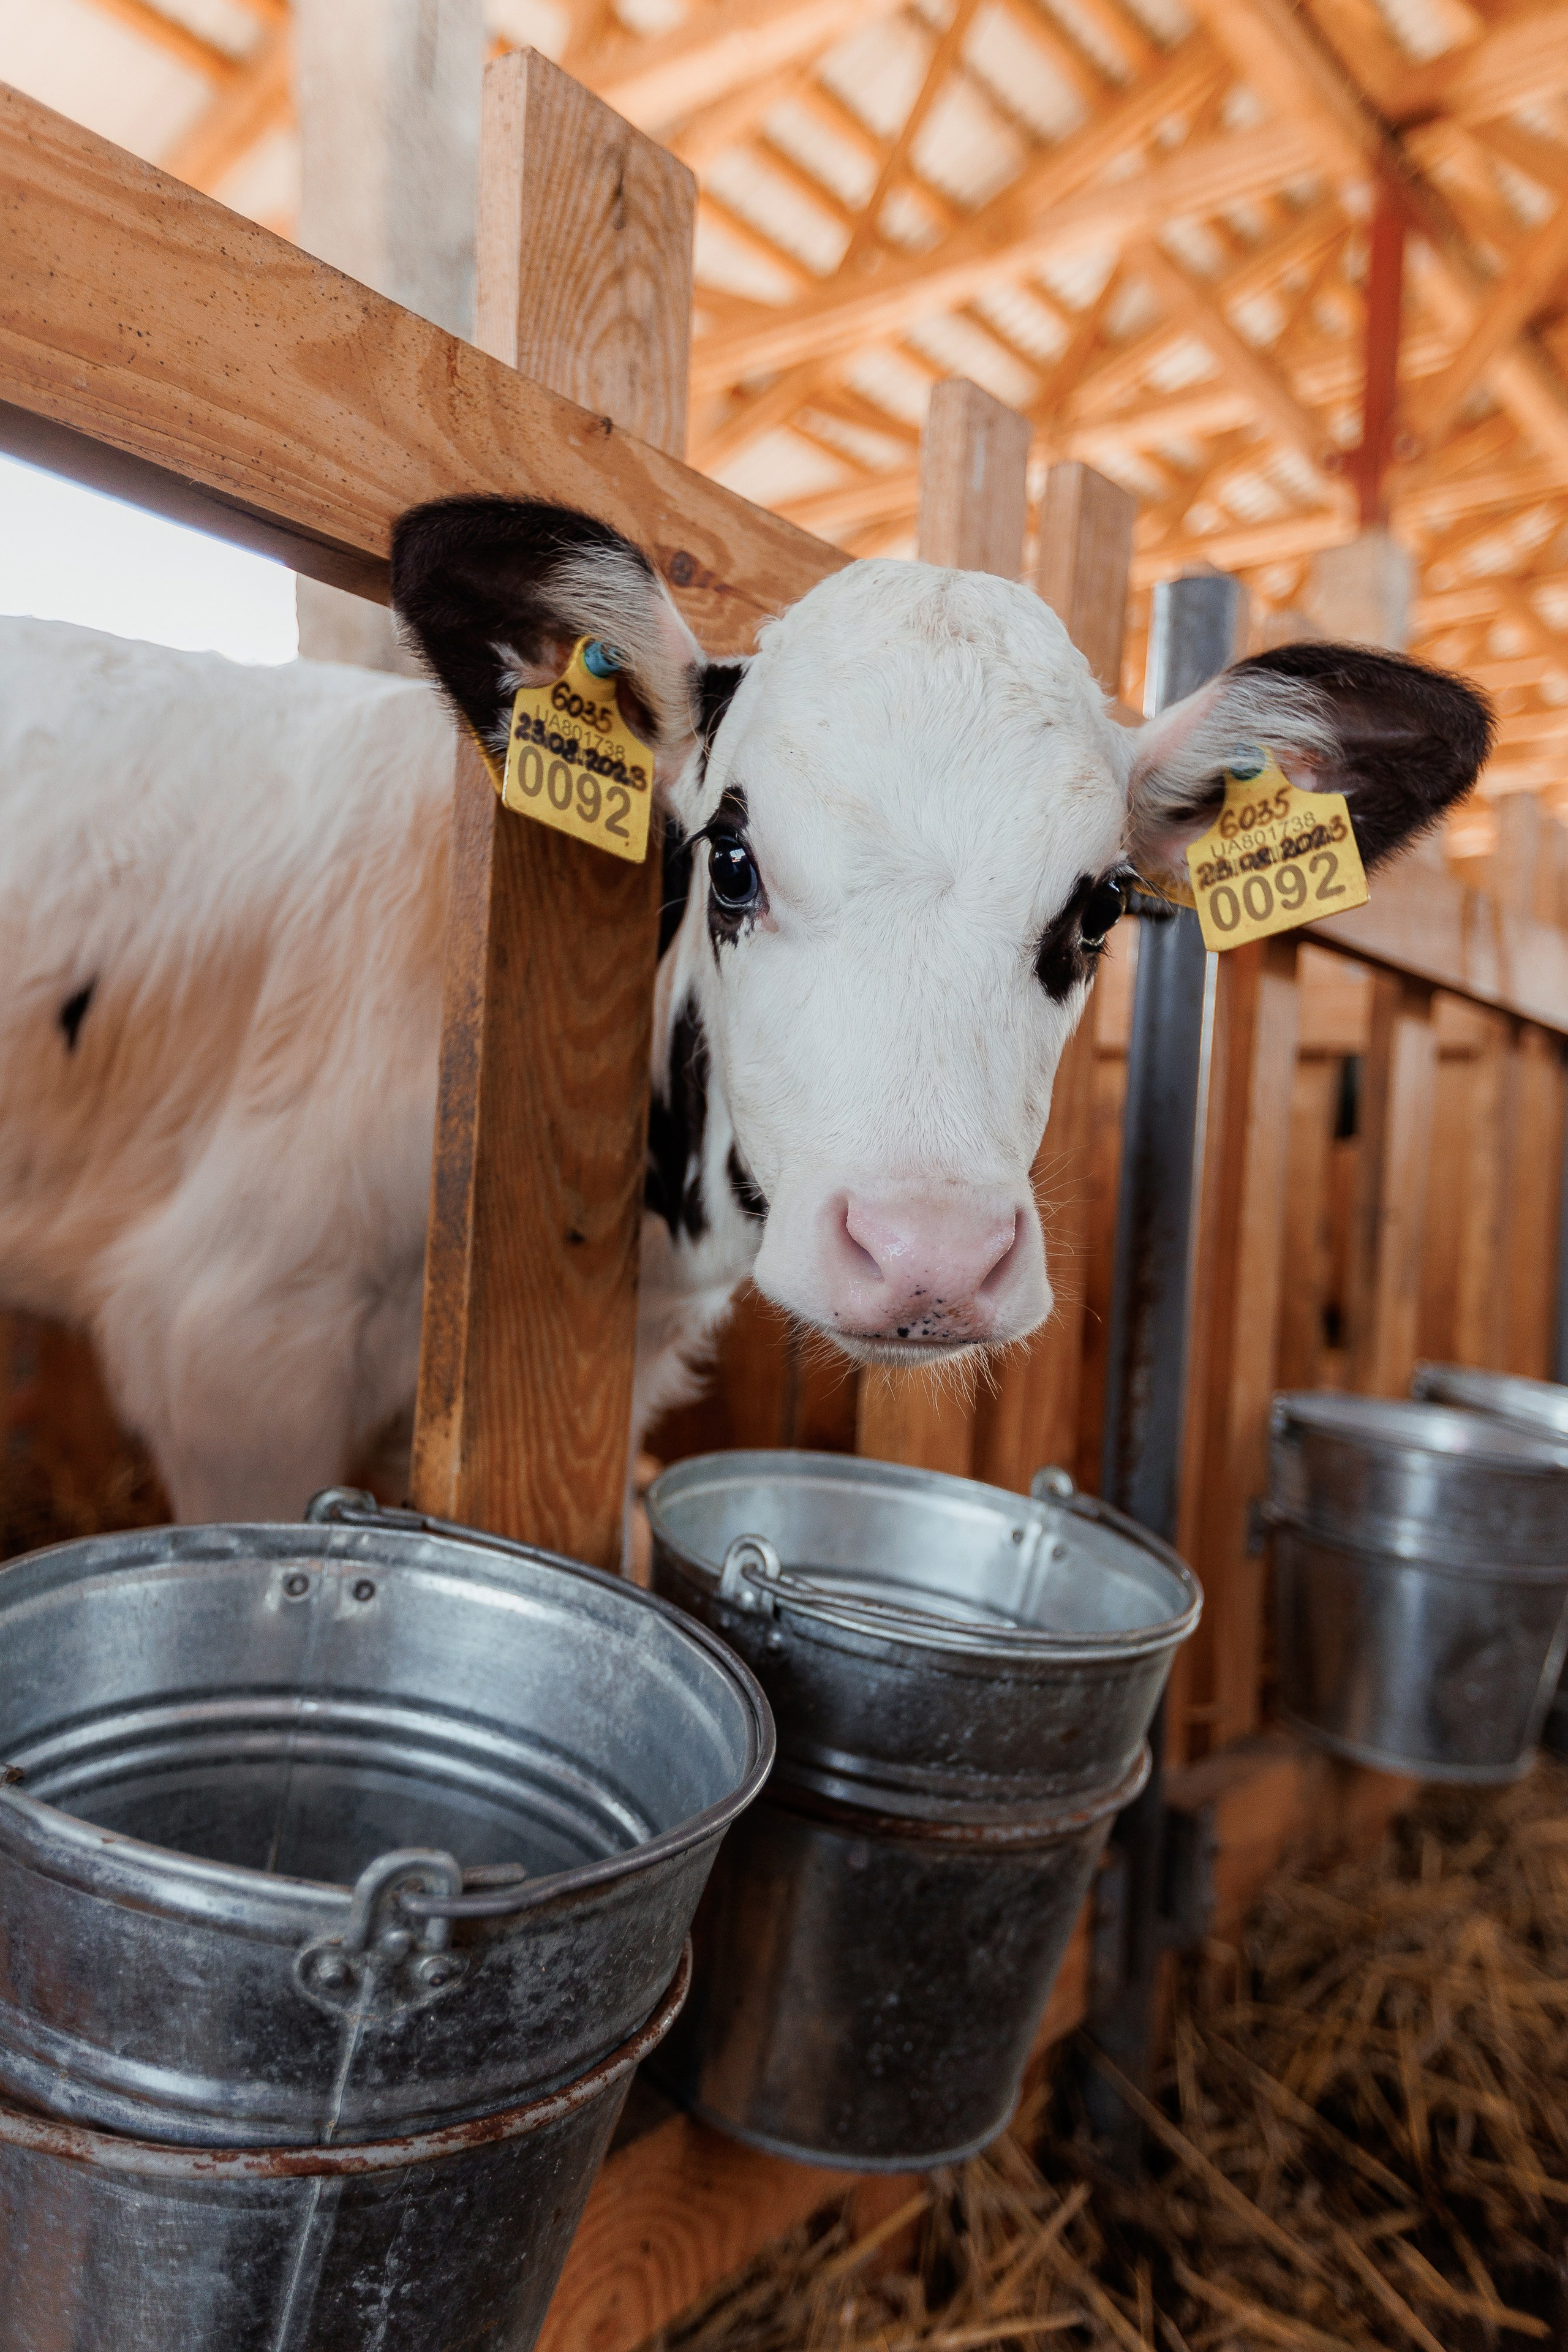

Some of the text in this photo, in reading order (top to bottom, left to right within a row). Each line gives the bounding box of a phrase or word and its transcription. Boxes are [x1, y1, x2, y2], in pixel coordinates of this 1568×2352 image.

[552, 680, 612, 734] 6035
[518, 745, 631, 839] 0092
[1218, 785, 1292, 840] 6035
[1210, 811, 1316, 859] UA801738
[1208, 851, 1346, 932] 0092
